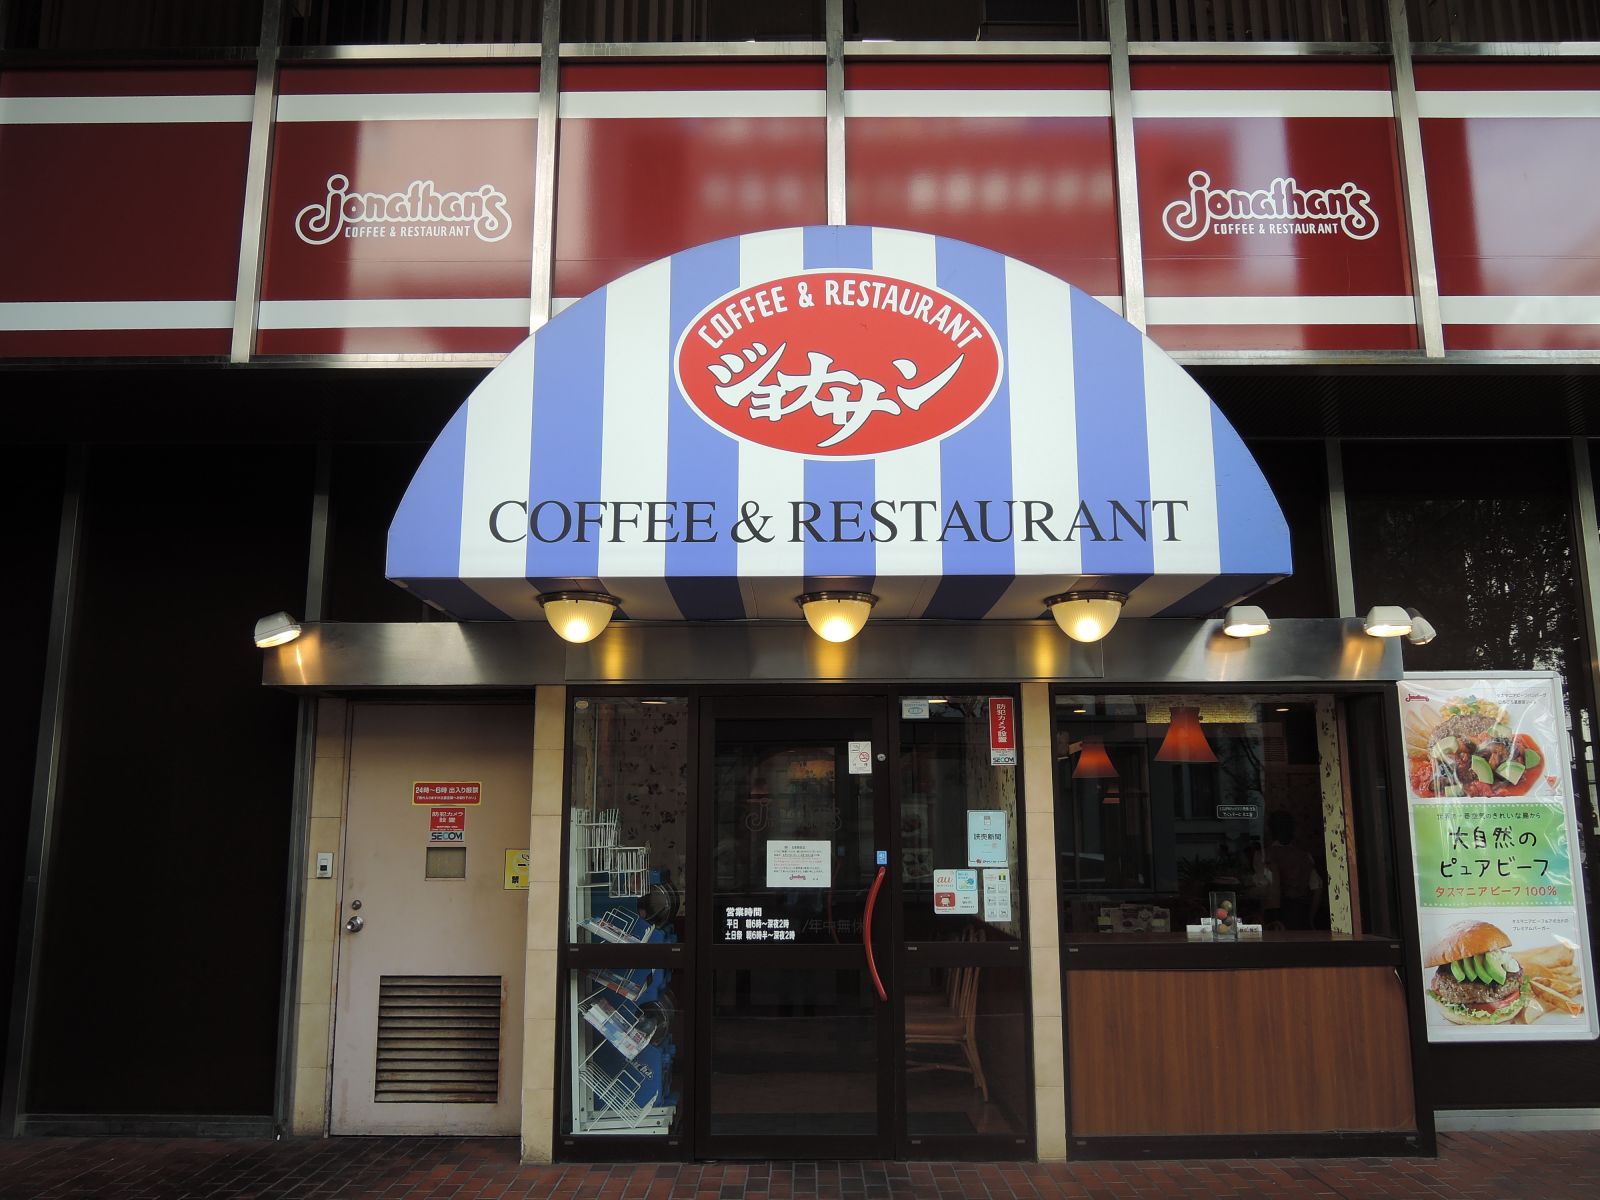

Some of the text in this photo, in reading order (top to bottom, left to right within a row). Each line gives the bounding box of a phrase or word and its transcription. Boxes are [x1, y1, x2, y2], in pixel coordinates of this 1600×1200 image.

[344, 226, 471, 238] COFFEE & RESTAURANT
[1213, 223, 1339, 235] COFFEE & RESTAURANT
[697, 279, 983, 350] COFFEE & RESTAURANT
[706, 341, 966, 448] ジョナサン
[488, 500, 1189, 544] COFFEE & RESTAURANT
[996, 703, 1008, 743] 防犯カメラ設置
[431, 832, 463, 840] SECOM
[1449, 825, 1537, 850] 大自然の
[1440, 856, 1549, 878] ピュアビーフ
[1435, 886, 1557, 898] タスマニアビーフ 100%
[725, 906, 763, 917] 営業時間
[726, 918, 739, 929] 平日
